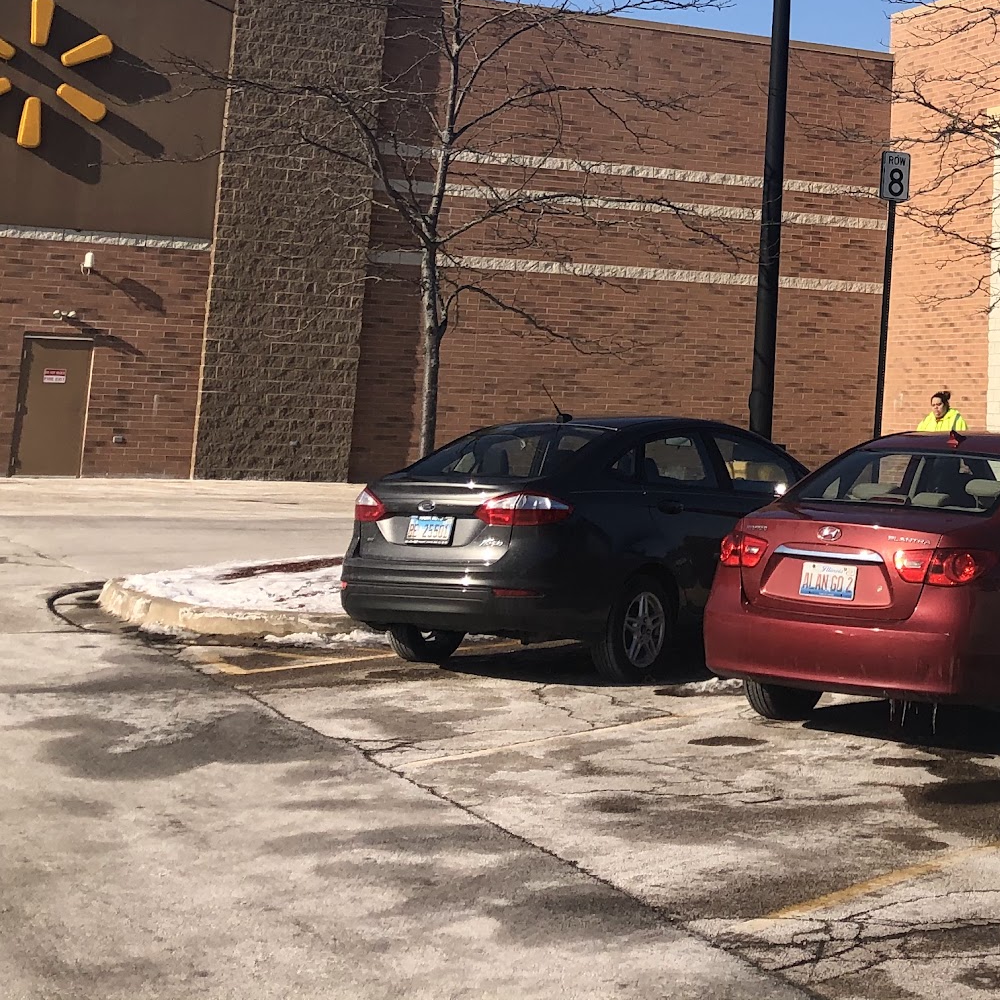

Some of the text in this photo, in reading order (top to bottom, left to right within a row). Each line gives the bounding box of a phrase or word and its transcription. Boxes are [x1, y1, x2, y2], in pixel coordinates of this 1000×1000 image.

[889, 156, 906, 166] ROW
[889, 168, 904, 197] 8
[846, 576, 853, 593] 2
